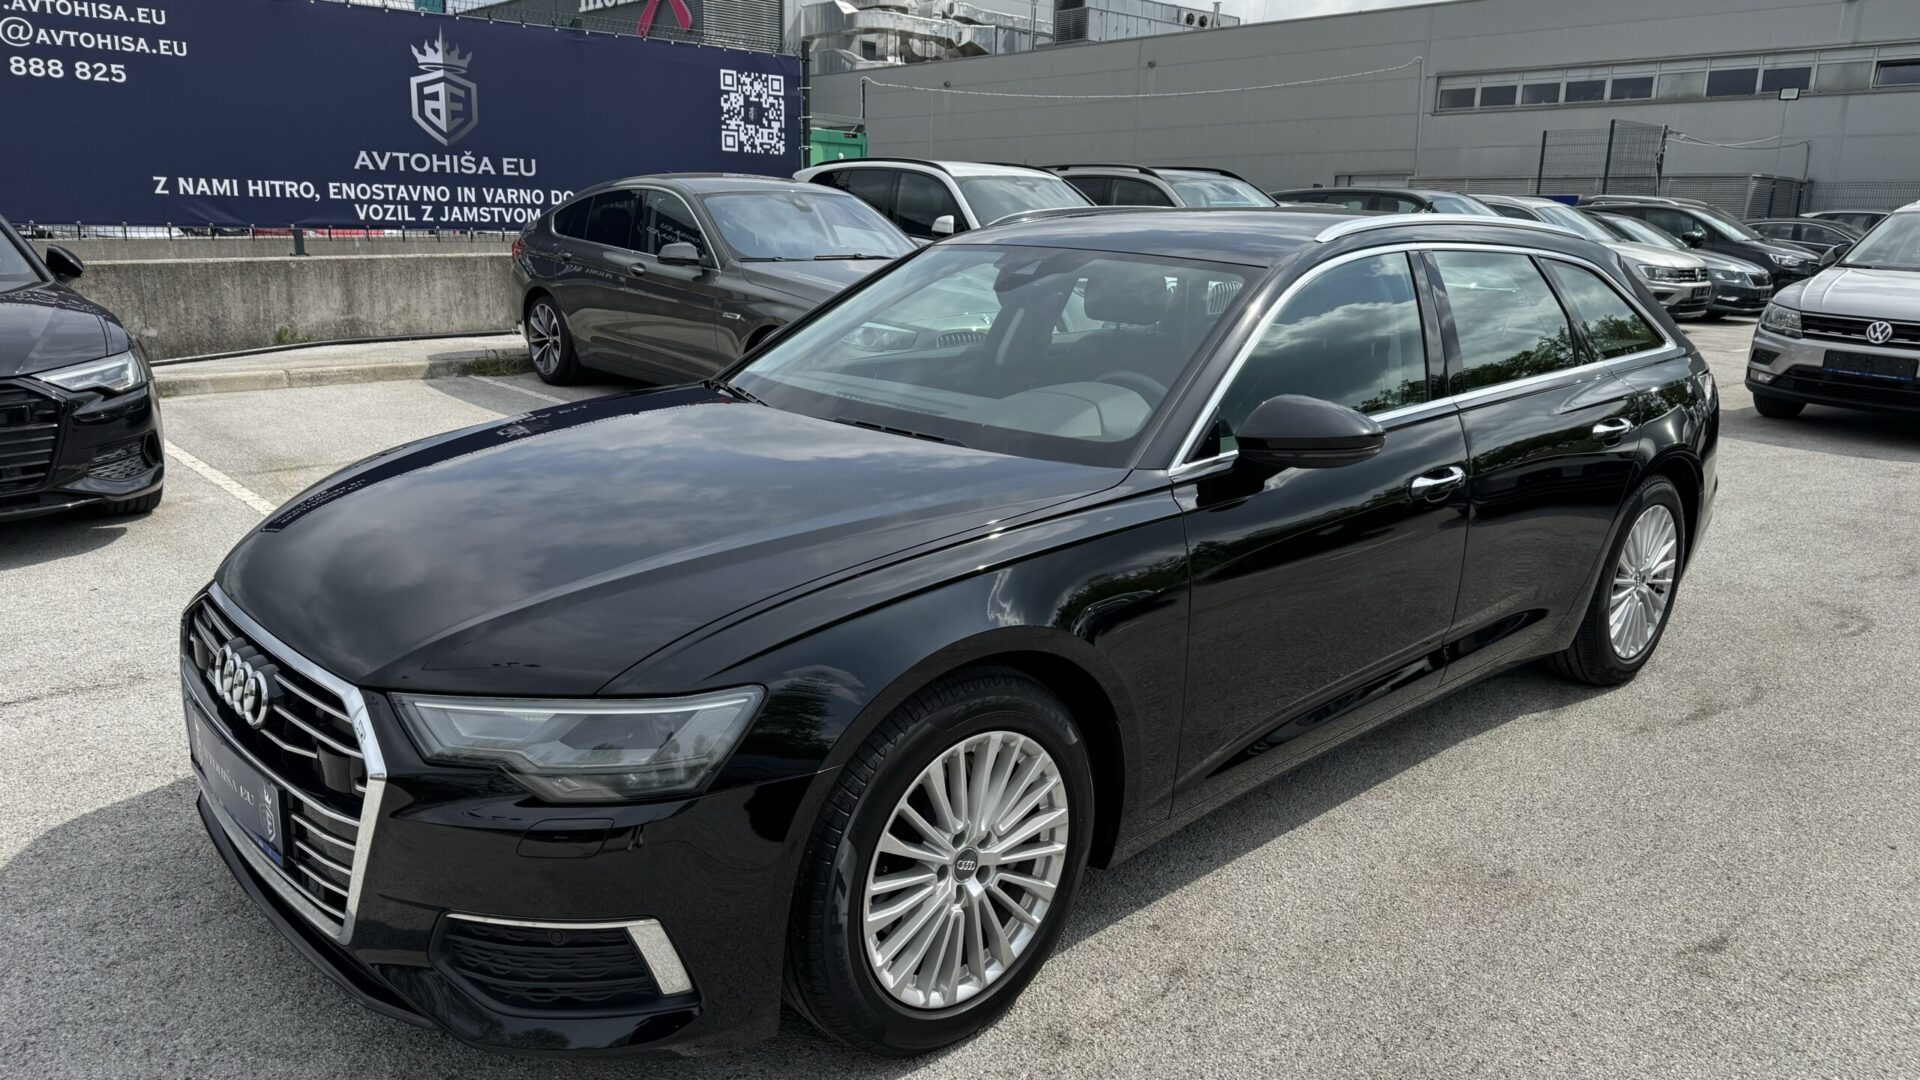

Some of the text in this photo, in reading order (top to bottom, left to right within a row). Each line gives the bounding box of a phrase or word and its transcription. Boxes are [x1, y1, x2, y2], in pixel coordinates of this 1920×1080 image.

[0, 16, 188, 57] @AVTOHISA.EU
[9, 55, 127, 83] 888 825
[353, 150, 536, 177] AVTOHIŠA EU
[152, 175, 170, 195] Z
[177, 176, 239, 197] NAMI
[247, 179, 321, 202] HITRO,
[328, 182, 451, 202] ENOSTAVNO
[457, 186, 476, 203] IN
[481, 187, 545, 205] VARNO
[354, 203, 542, 224] VOZIL Z JAMSTVOM
[239, 785, 255, 806] EU
